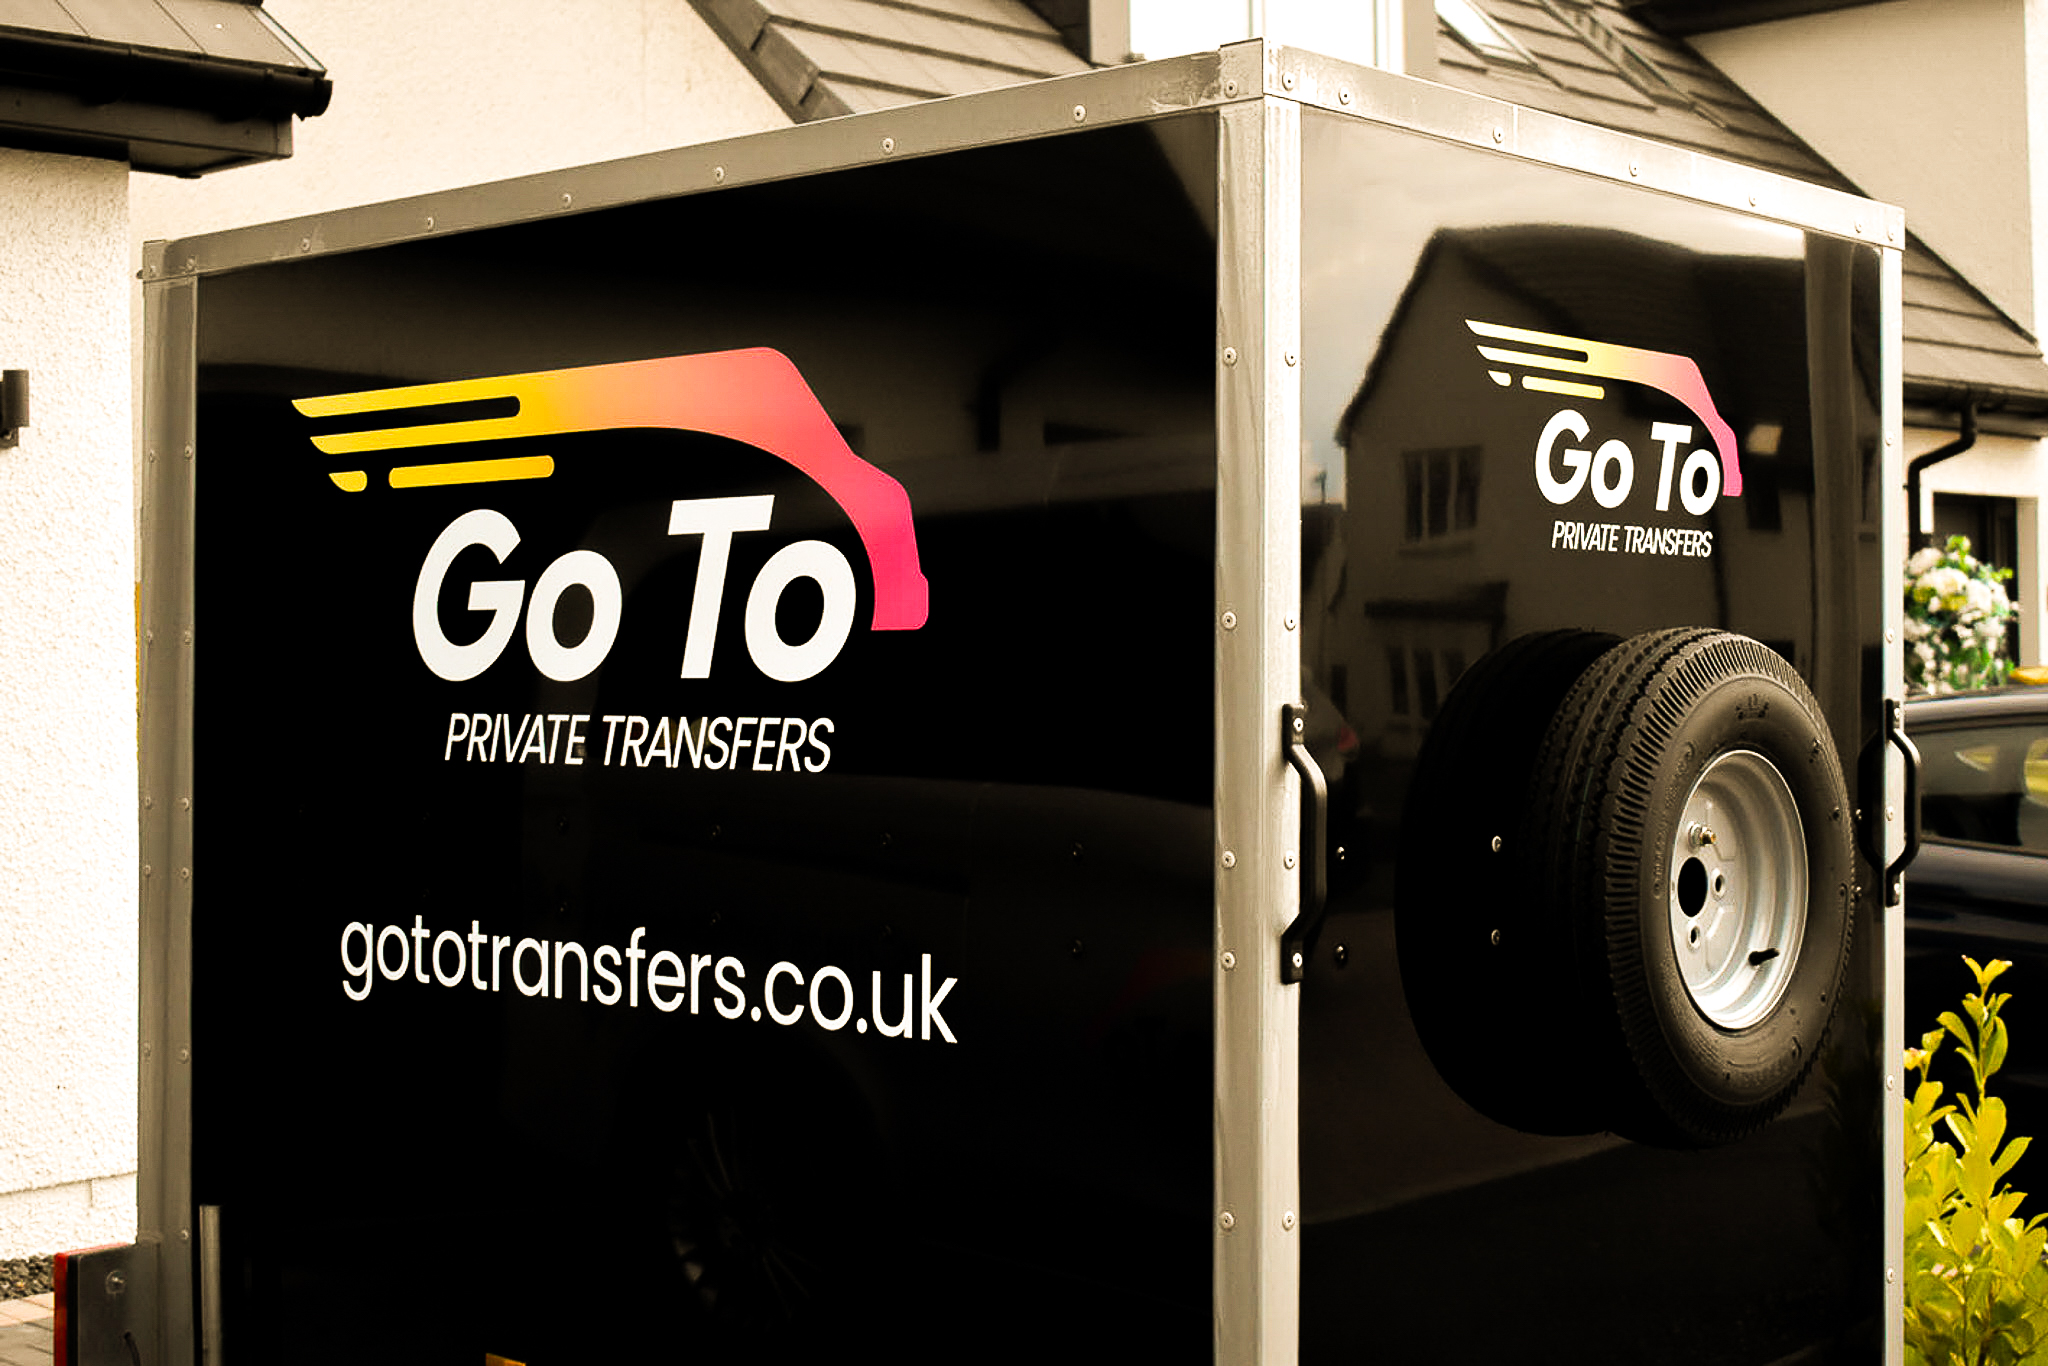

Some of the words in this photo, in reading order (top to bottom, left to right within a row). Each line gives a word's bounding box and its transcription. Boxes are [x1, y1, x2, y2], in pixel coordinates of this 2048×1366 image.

[1536, 410, 1633, 508] Go
[1651, 422, 1720, 515] To
[413, 509, 622, 681] Go
[668, 495, 856, 681] To
[1552, 521, 1620, 551] PRIVATE
[1624, 525, 1713, 558] TRANSFERS
[445, 713, 591, 765] PRIVATE
[603, 715, 834, 773] TRANSFERS
[341, 915, 958, 1044] gototransfers.co.uk
